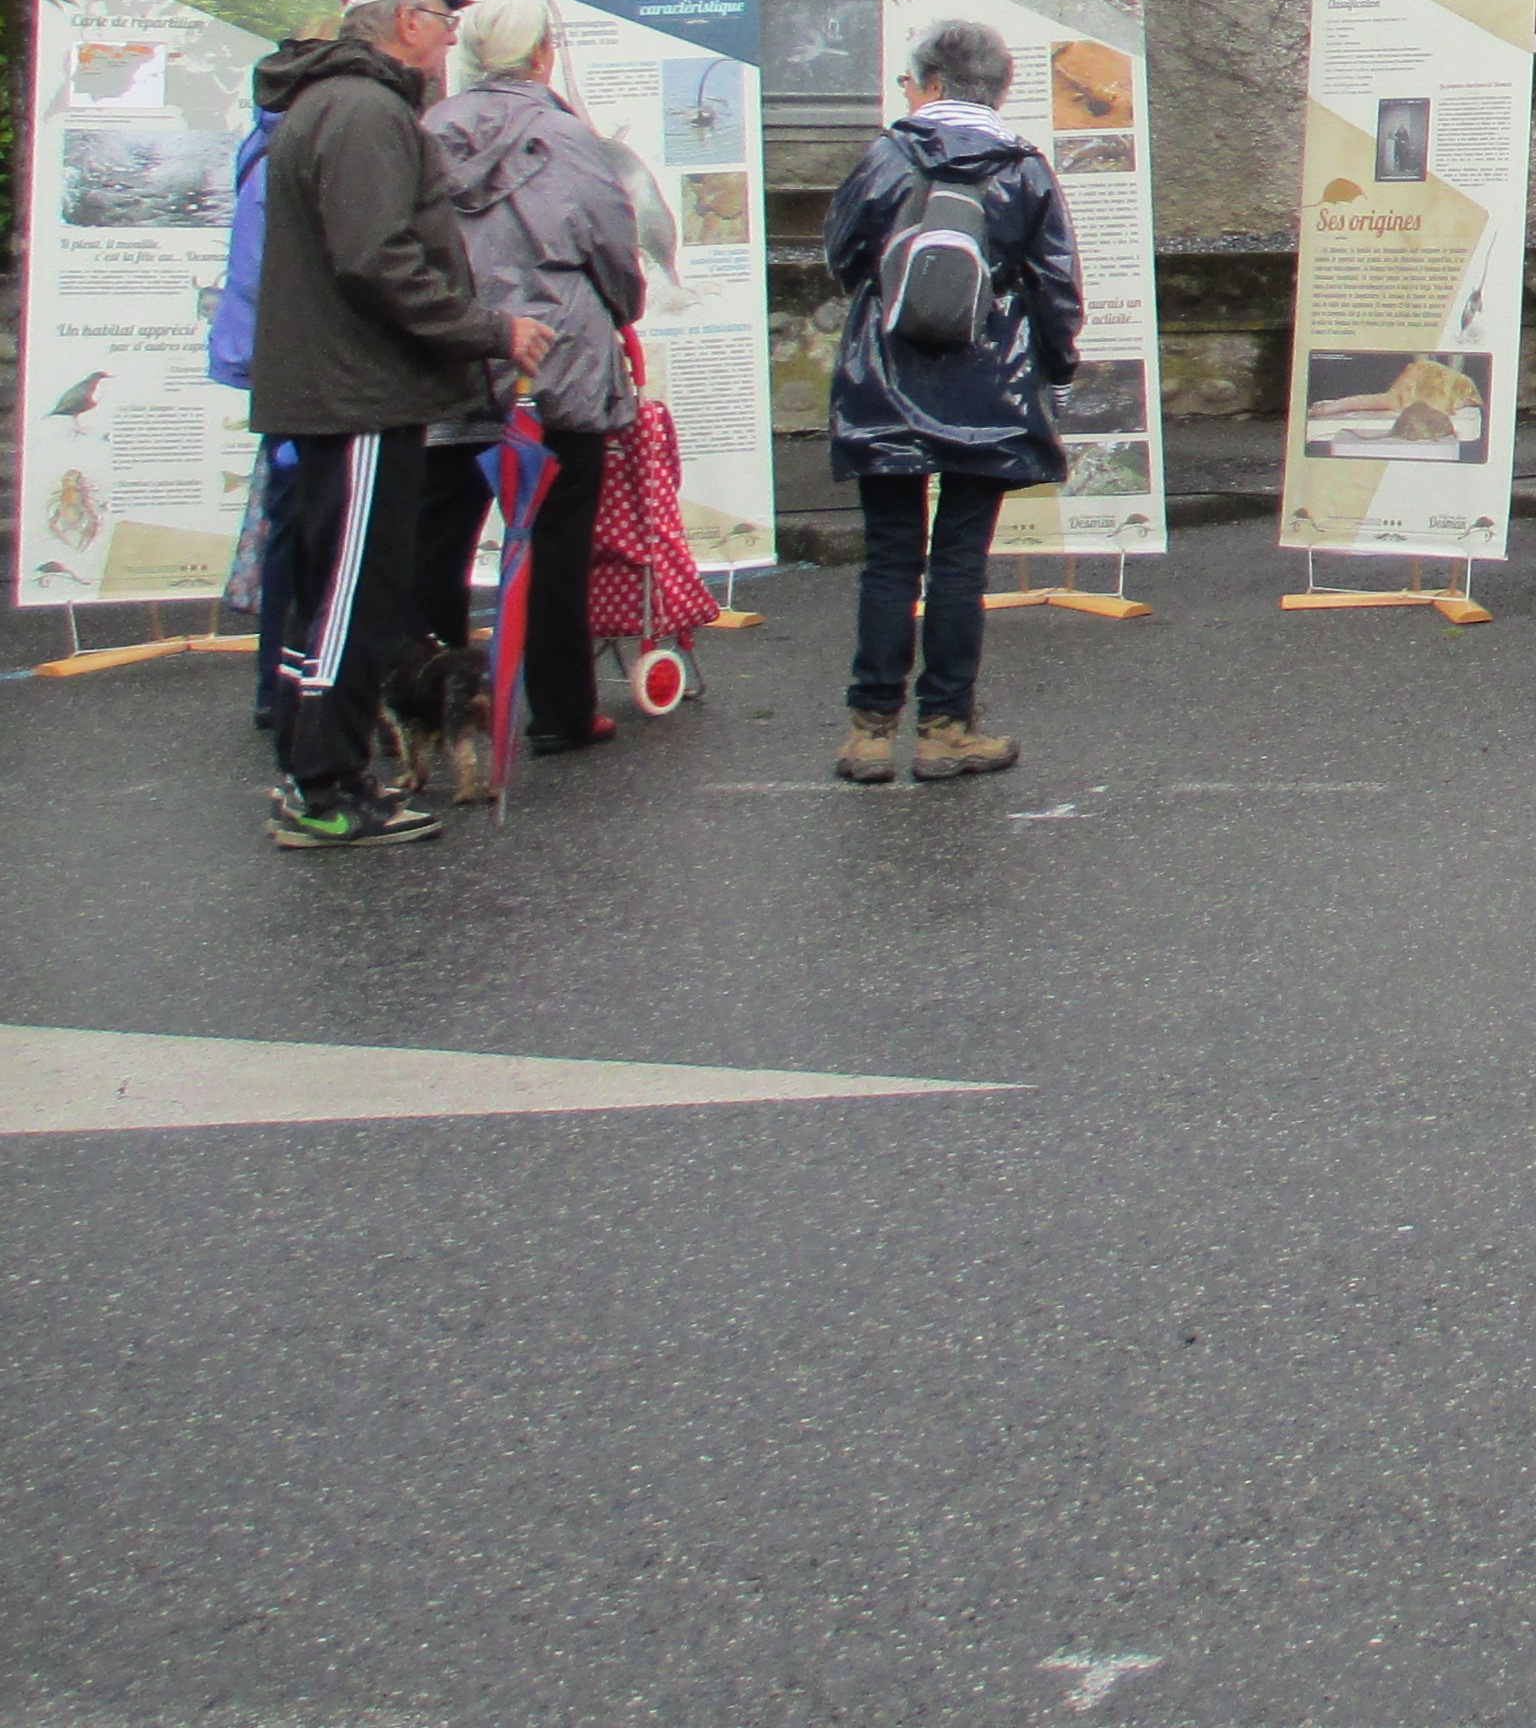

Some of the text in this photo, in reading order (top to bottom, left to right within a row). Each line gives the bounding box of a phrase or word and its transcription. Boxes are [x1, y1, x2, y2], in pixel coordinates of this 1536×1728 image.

[639, 0, 745, 17] caractéristique
[1315, 208, 1422, 239] Ses origines
[1126, 298, 1143, 308] un
